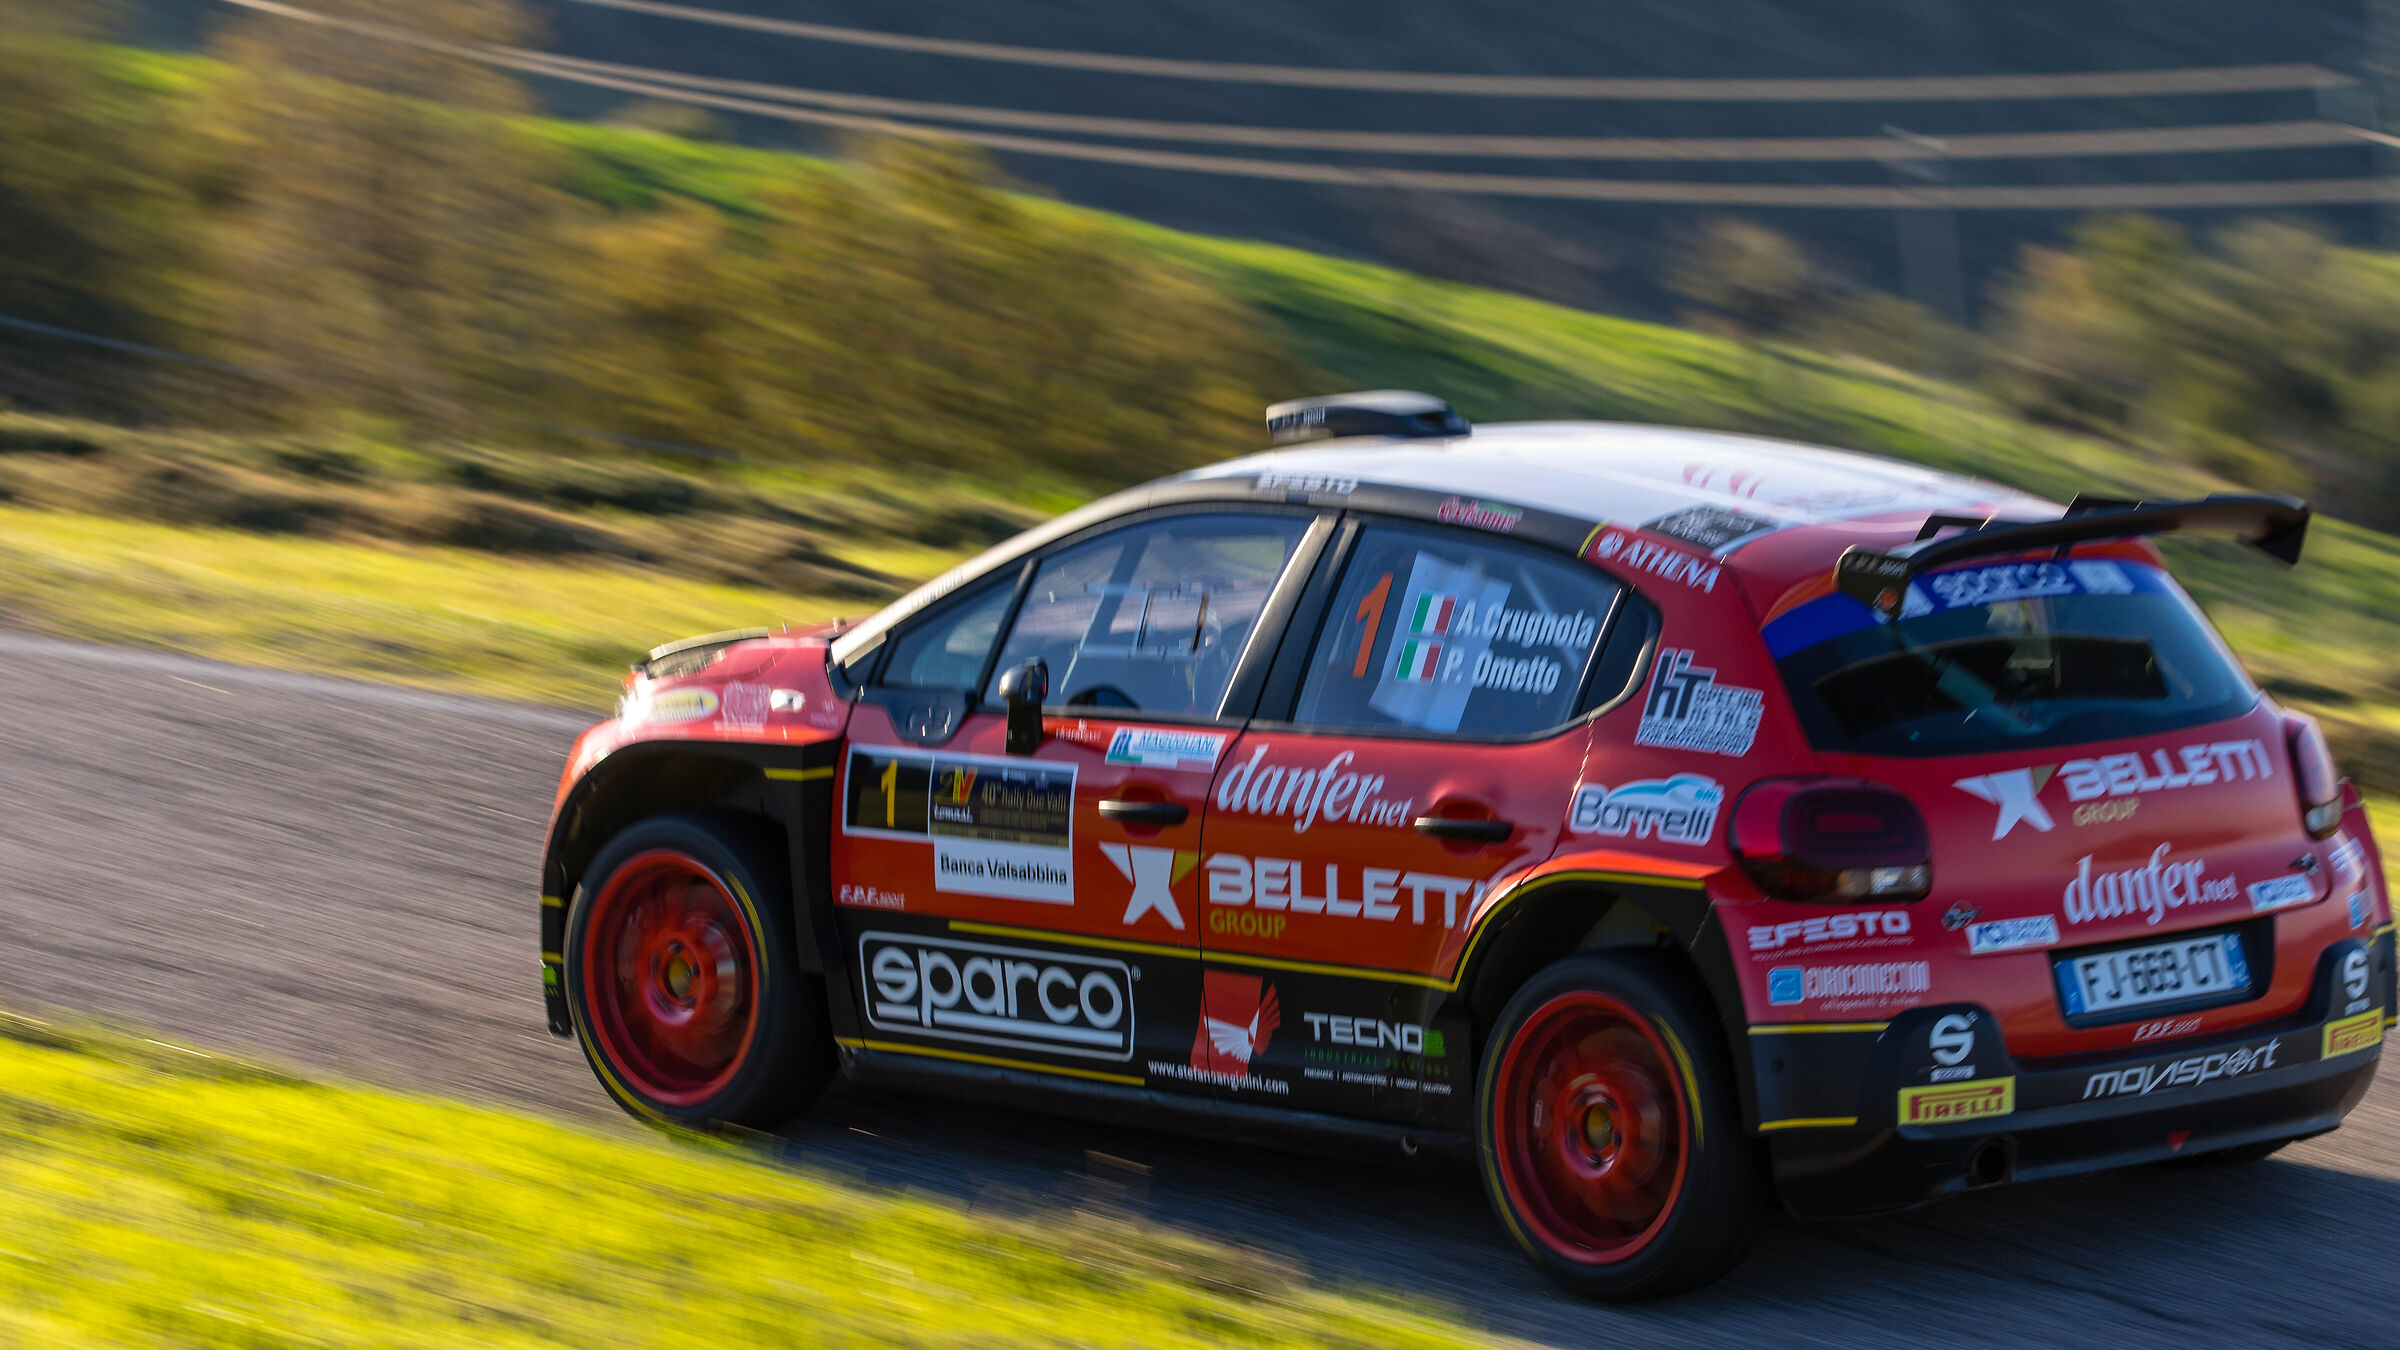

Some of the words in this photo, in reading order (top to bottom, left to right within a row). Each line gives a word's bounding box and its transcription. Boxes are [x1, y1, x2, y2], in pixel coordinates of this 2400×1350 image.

[1617, 539, 1721, 594] ATHENA
[1353, 572, 1394, 679] 1
[1442, 646, 1465, 685] P.
[1473, 649, 1561, 694] Ometto
[881, 758, 898, 829] 1
[1218, 743, 1413, 833] danfer.net
[2057, 739, 2272, 802] BELLETTI
[1002, 786, 1024, 810] Rally
[1026, 787, 1045, 811] Due
[1574, 789, 1712, 840] Borrelli
[2073, 798, 2140, 827] GROUP
[940, 852, 984, 876] Banca
[987, 857, 1068, 886] Valsabbina
[2064, 841, 2239, 926] danfer.net
[1209, 908, 1287, 939] GROUP
[1748, 911, 1911, 950] EFESTO
[871, 947, 1123, 1030] sparco
[1304, 1012, 1422, 1054] TECNO
[2328, 1014, 2379, 1054] PIRELLI
[1910, 1085, 2005, 1121] PIRELLI
